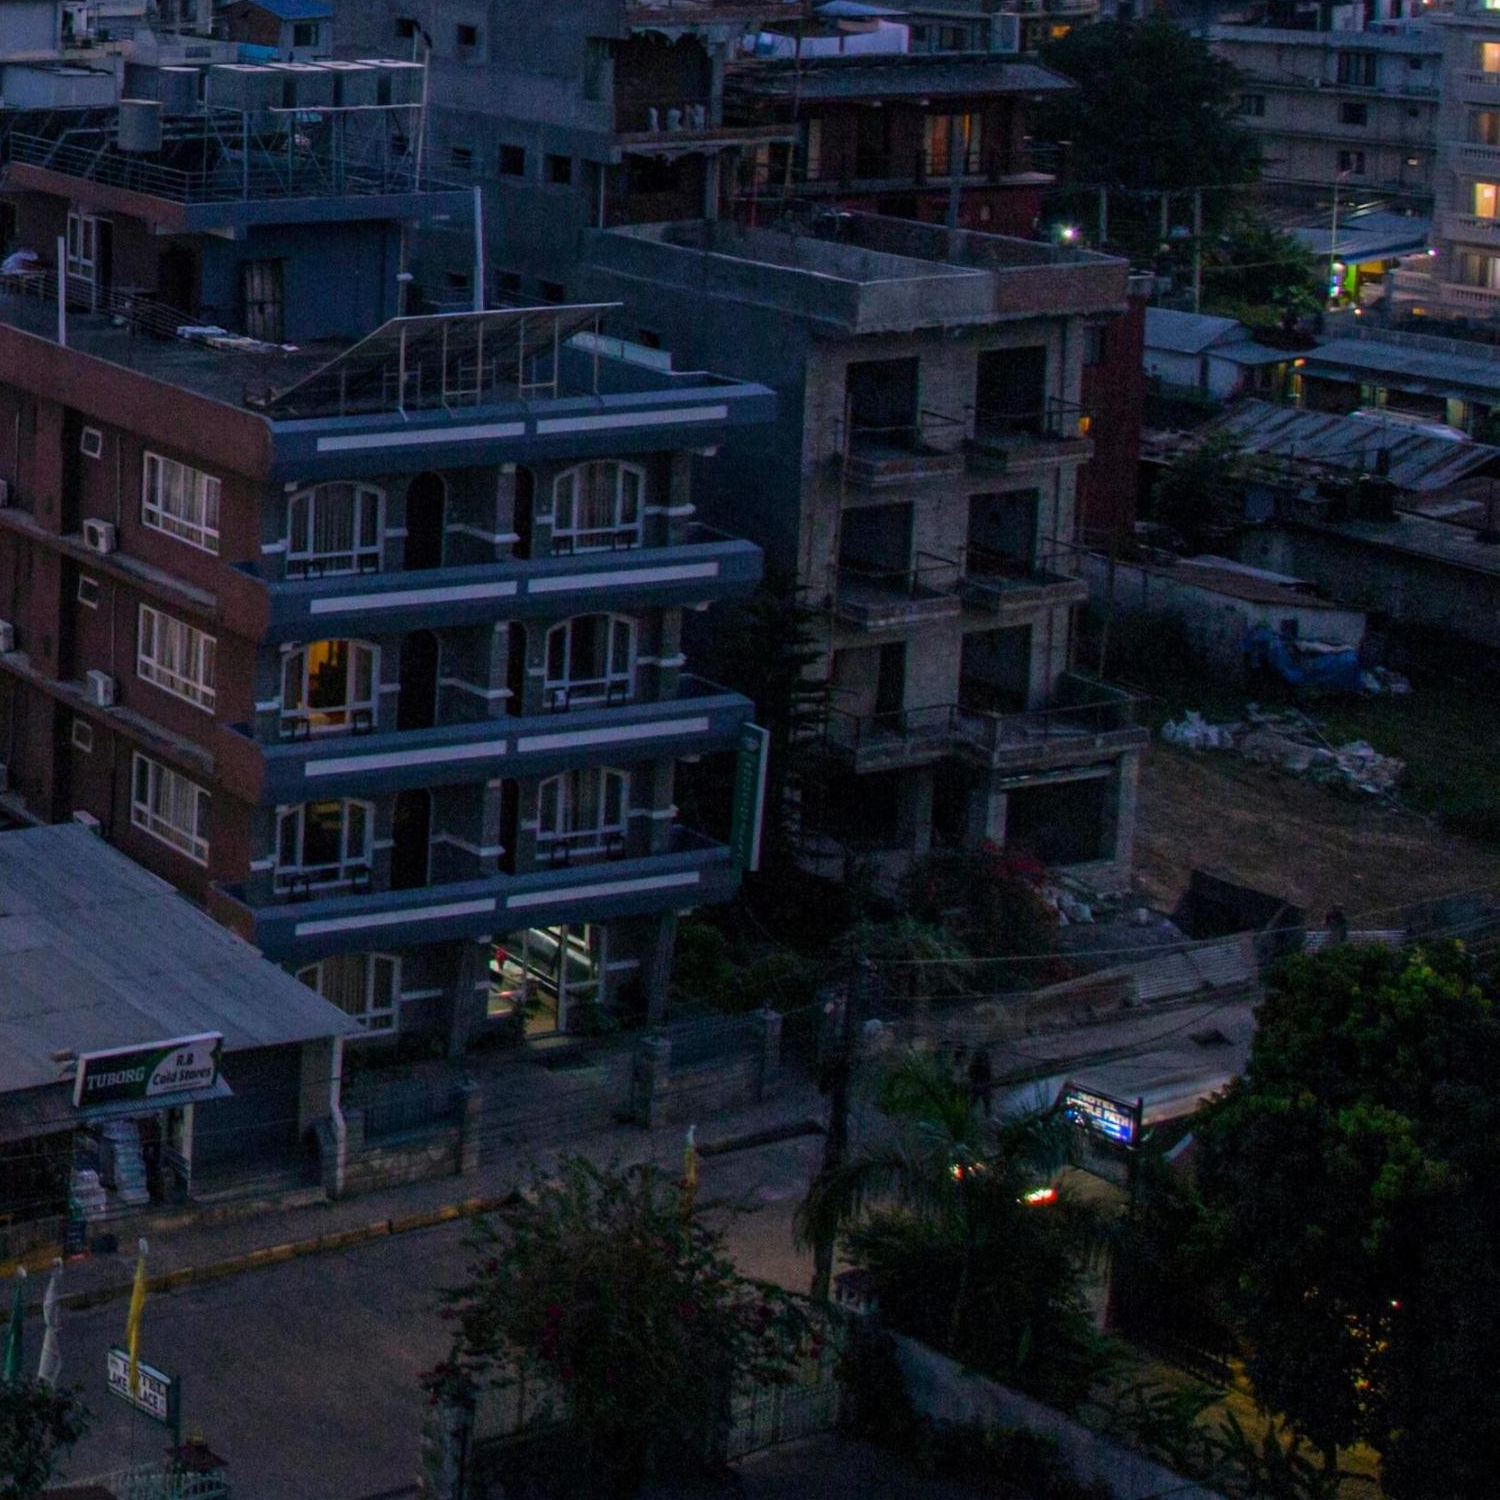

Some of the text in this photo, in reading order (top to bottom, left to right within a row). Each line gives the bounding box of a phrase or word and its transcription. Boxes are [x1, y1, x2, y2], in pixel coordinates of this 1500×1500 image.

[87, 1066, 147, 1091] TUBORG
[152, 1071, 178, 1086] Cold
[179, 1066, 213, 1081] Stores
[108, 1371, 128, 1392] LAKE
